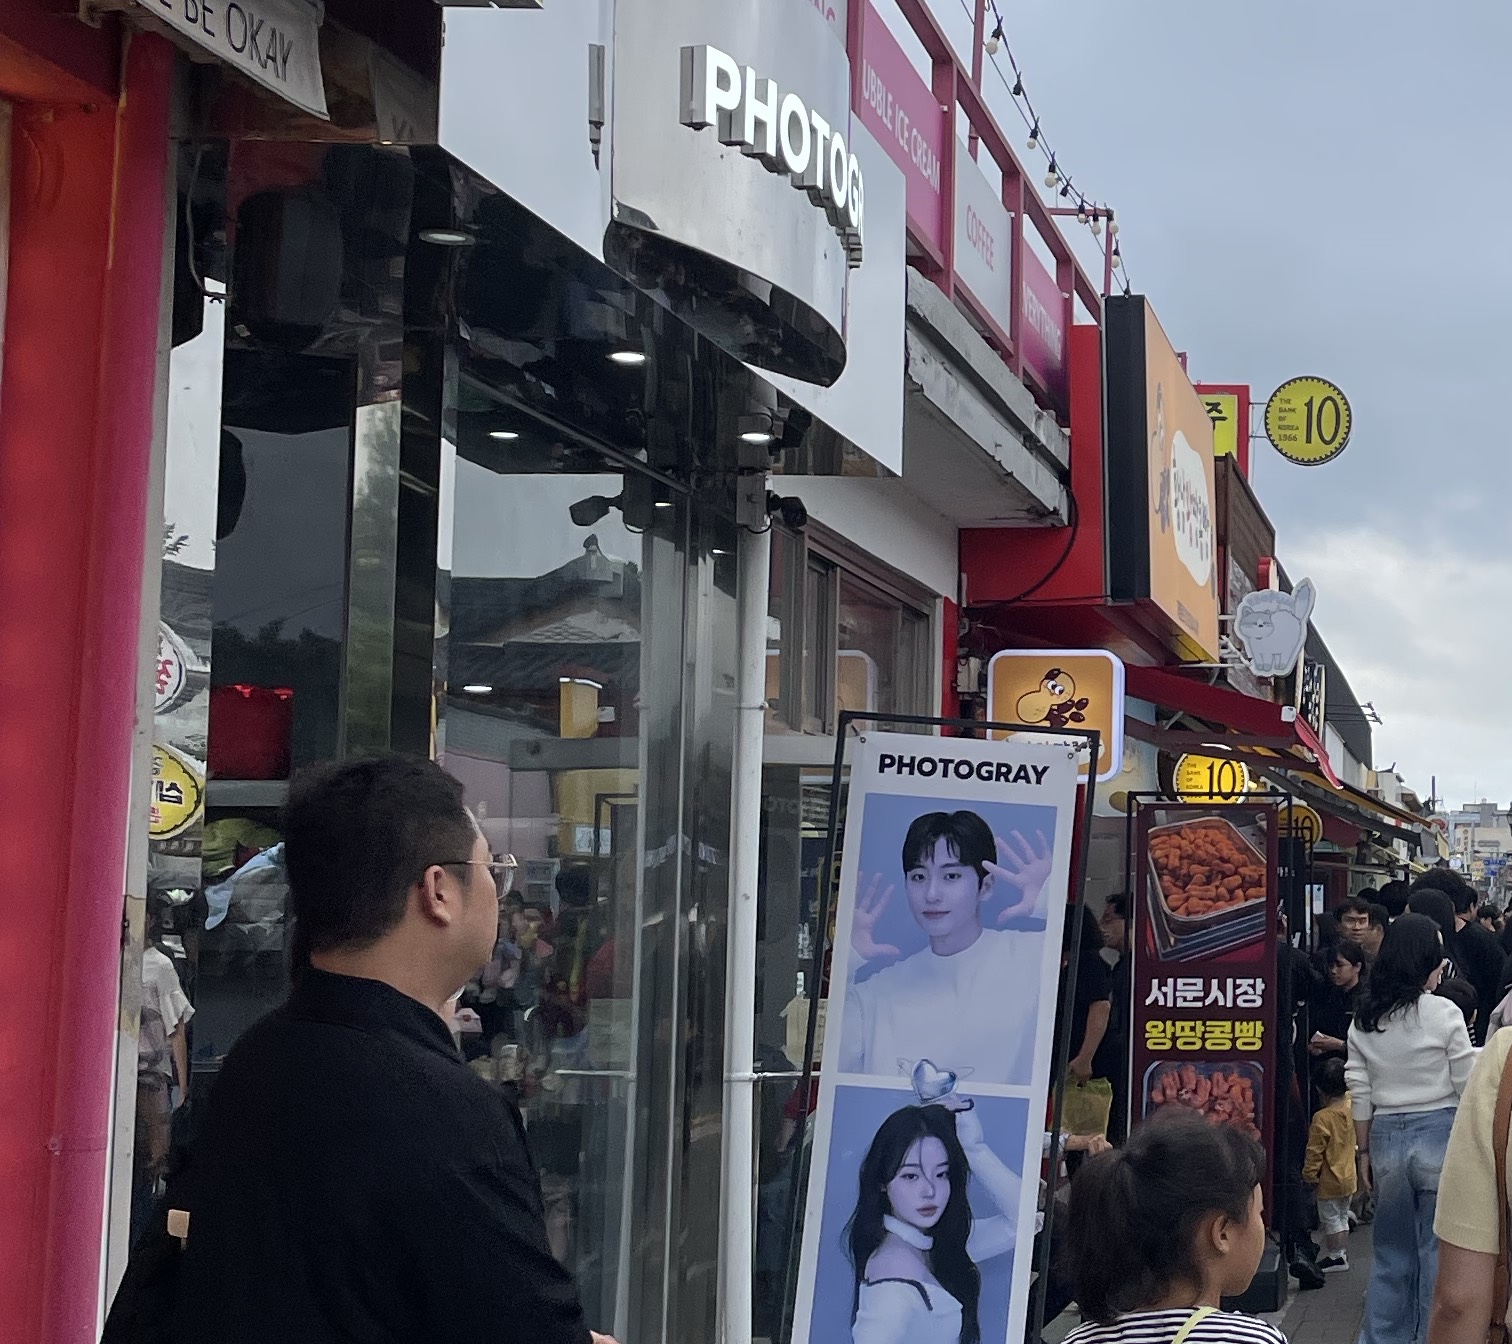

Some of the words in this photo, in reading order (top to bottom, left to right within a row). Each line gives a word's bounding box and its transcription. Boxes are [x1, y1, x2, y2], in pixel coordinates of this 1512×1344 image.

[225, 2, 294, 83] OKAY
[862, 58, 893, 131] UBBLE
[894, 103, 909, 154] ICE
[911, 127, 941, 195] CREAM
[965, 205, 995, 273] COFFEE
[1304, 396, 1341, 446] 10
[878, 753, 1050, 786] PHOTOGRAY
[1207, 760, 1237, 801] 10
[1145, 977, 1266, 1008] 서문시장
[1144, 1019, 1265, 1051] 왕땅콩빵
